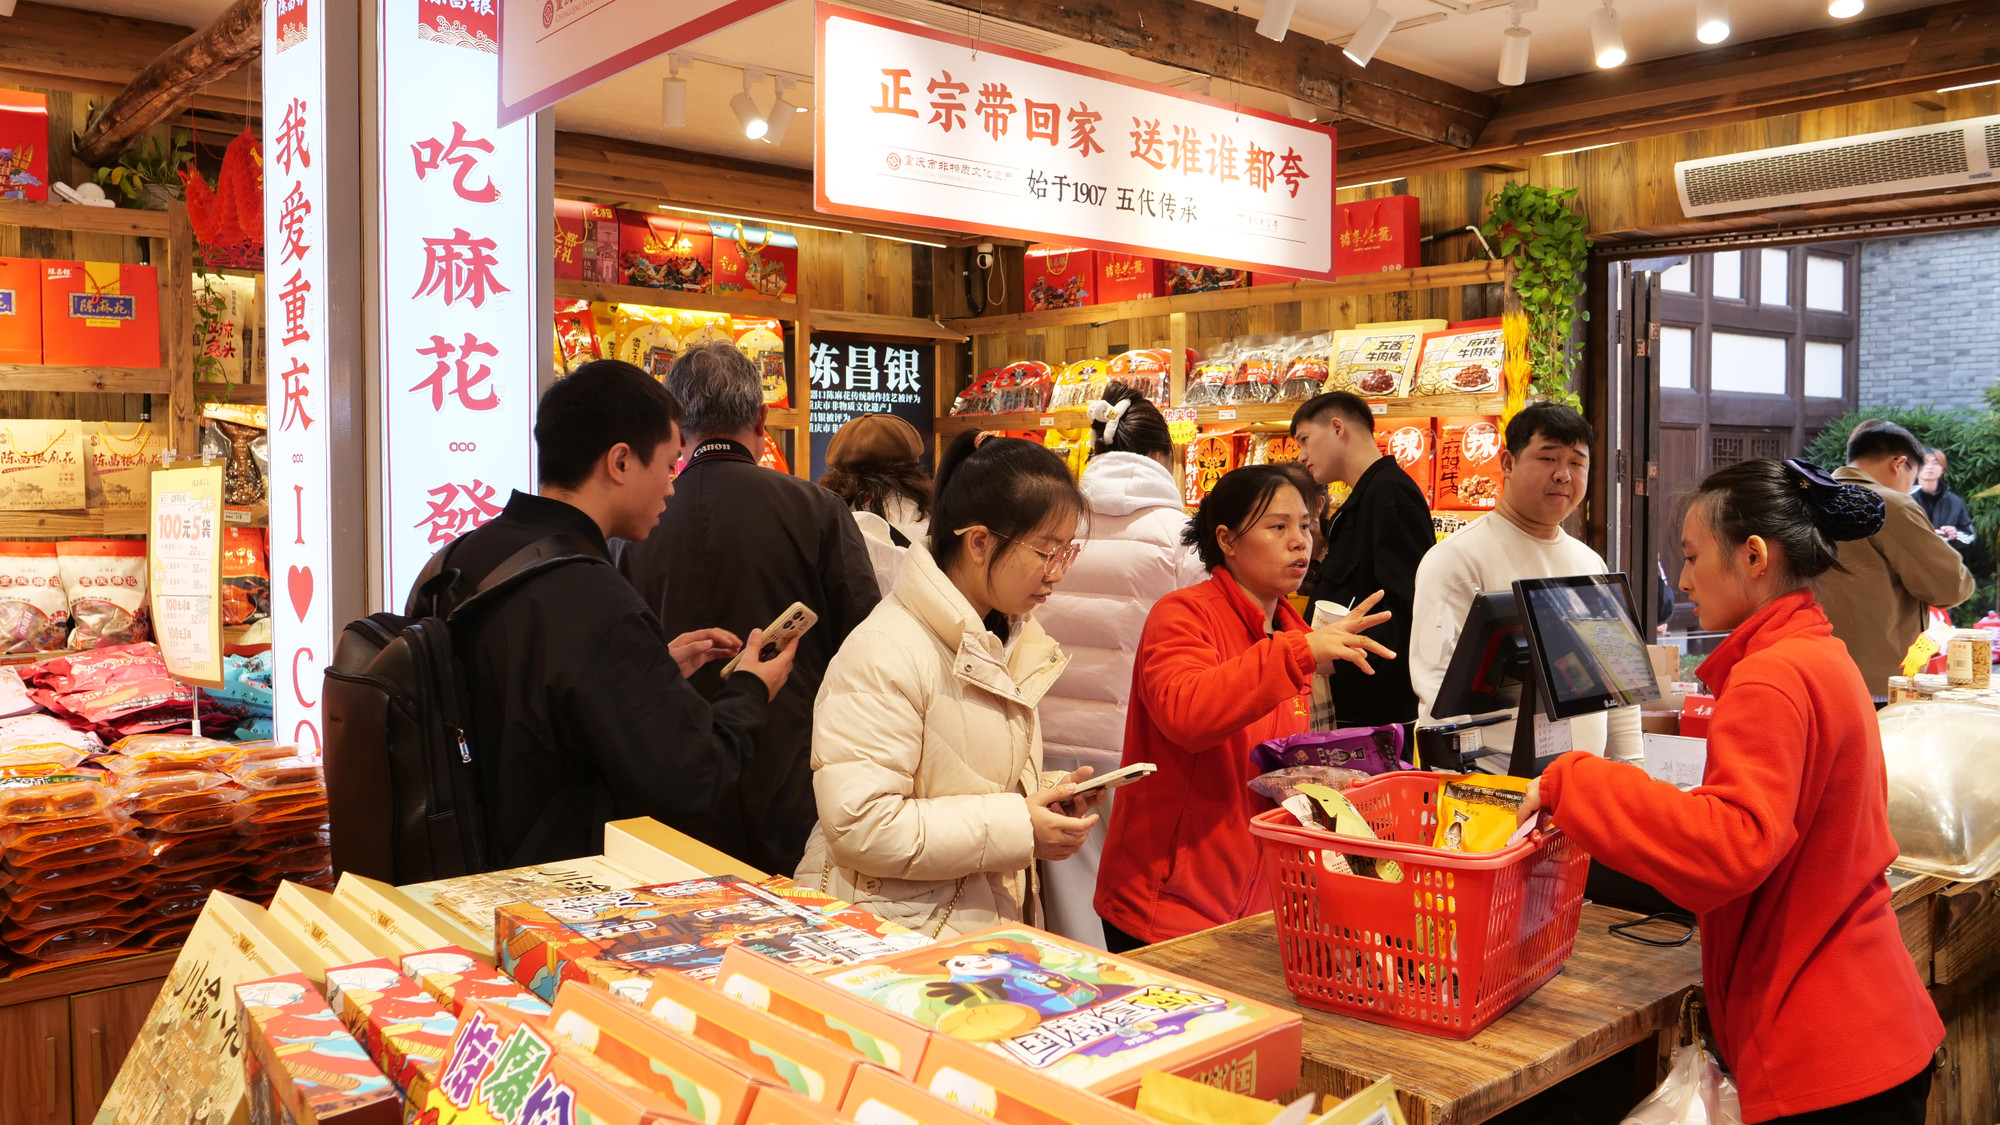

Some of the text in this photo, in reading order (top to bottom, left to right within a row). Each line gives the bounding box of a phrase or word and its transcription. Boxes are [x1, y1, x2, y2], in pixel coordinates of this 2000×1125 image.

[870, 69, 1311, 199] 正宗带回家 送谁谁都夸
[1027, 168, 1108, 207] 始于1907
[1116, 187, 1198, 224] 五代传承
[275, 97, 315, 432] 我爱重庆
[408, 120, 512, 412] 吃麻花
[1375, 339, 1403, 351] 五香
[1457, 346, 1497, 358] 牛肉棒
[1466, 336, 1498, 348] 麻辣
[1365, 351, 1402, 362] 牛肉棒
[1163, 409, 1197, 421] 热卖中
[693, 443, 731, 457] Canon
[1392, 430, 1421, 460] 辣
[1466, 425, 1497, 461] 辣
[1440, 438, 1461, 499] 麻辣牛肉
[158, 513, 211, 541] 100元5袋
[79, 576, 138, 588] 重庆麻花
